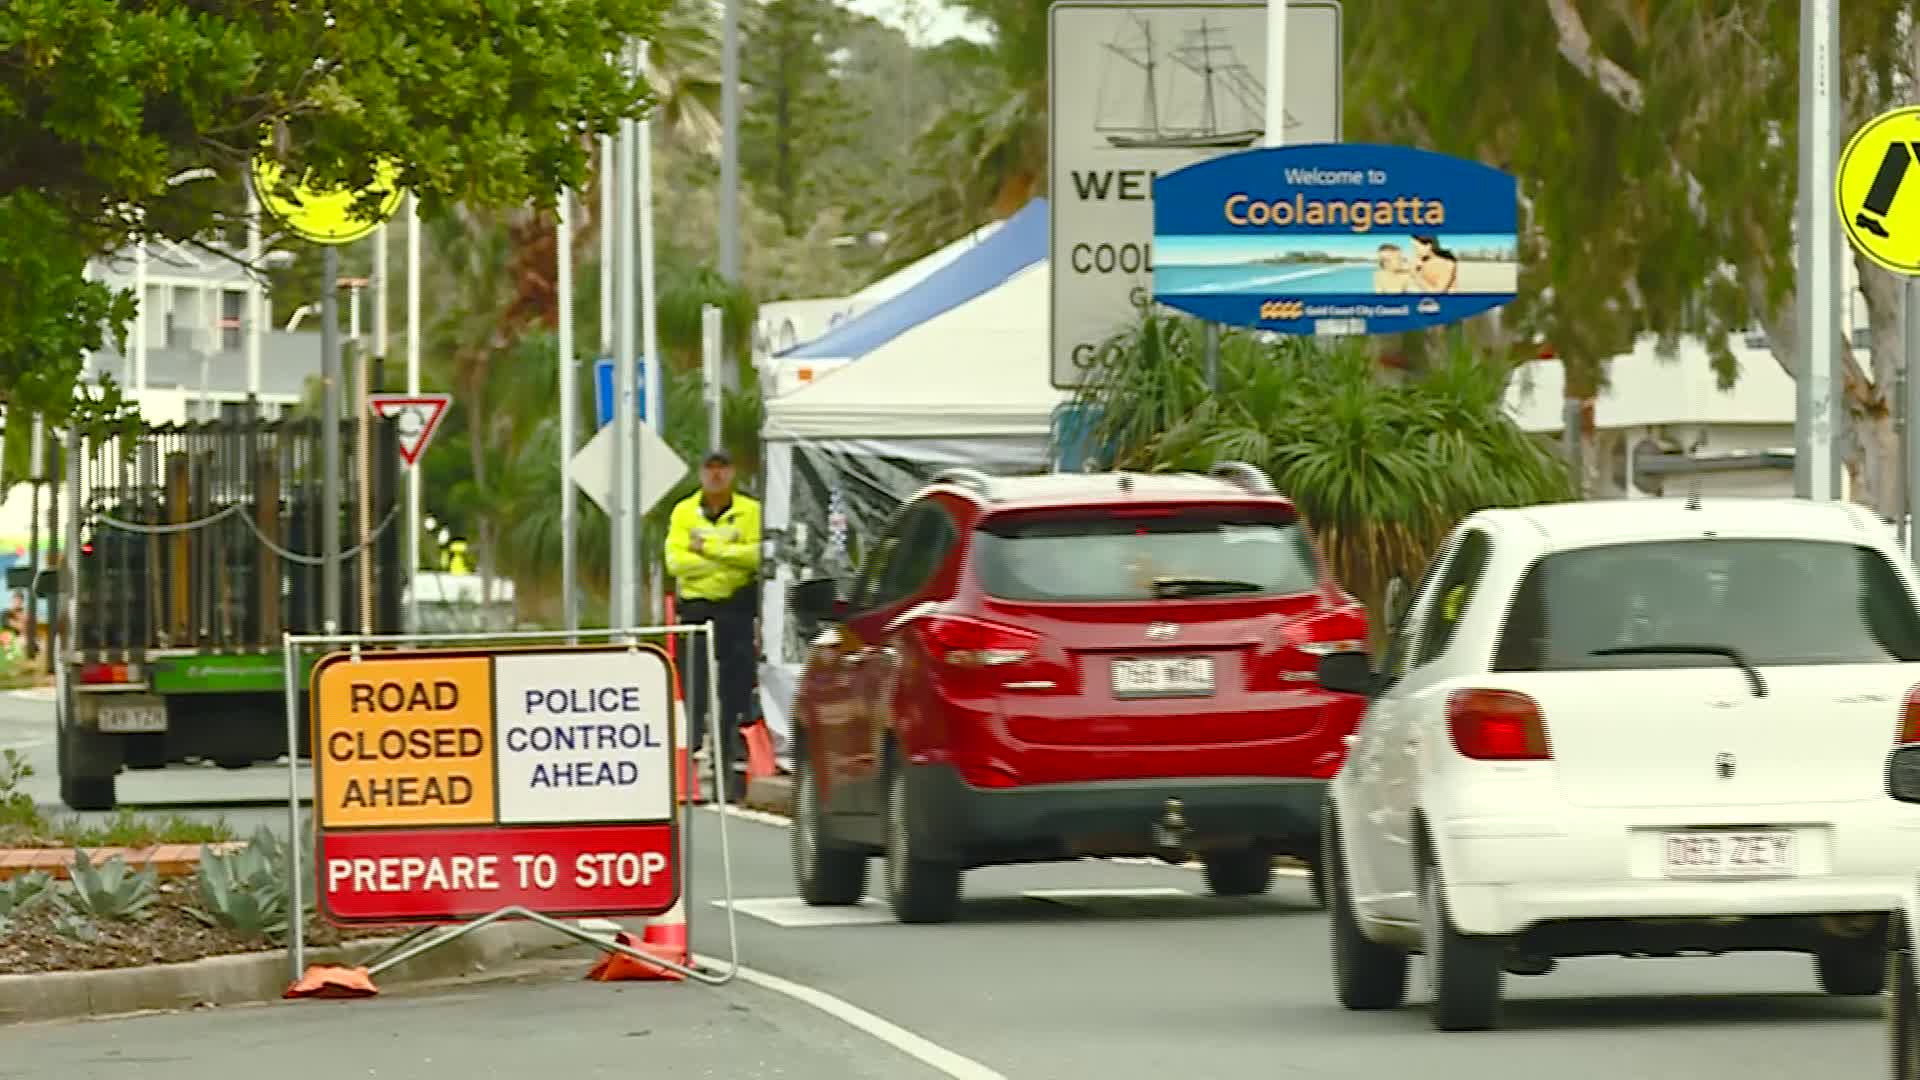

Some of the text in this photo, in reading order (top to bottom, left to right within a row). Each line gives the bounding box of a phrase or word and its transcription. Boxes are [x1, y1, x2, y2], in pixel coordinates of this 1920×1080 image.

[1285, 168, 1387, 185] Welcome to
[1225, 194, 1445, 232] Coolangatta
[350, 682, 459, 714] ROAD
[525, 687, 640, 714] POLICE
[328, 728, 483, 761] CLOSED
[507, 724, 661, 752] CONTROL
[530, 761, 639, 788] AHEAD
[341, 776, 473, 808] AHEAD
[1727, 835, 1793, 864] ZEY
[328, 851, 666, 894] PREPARE TO STOP
